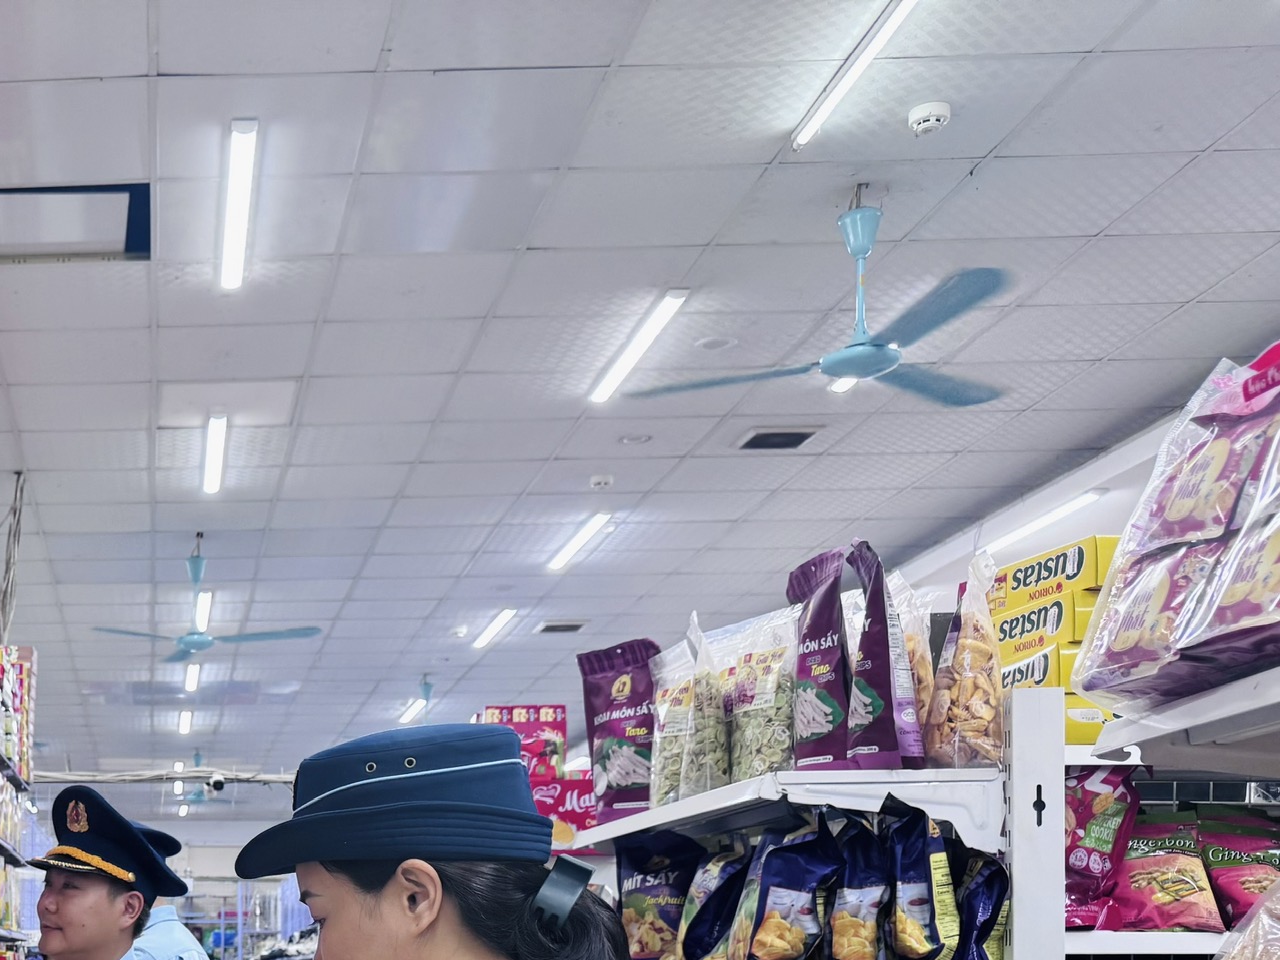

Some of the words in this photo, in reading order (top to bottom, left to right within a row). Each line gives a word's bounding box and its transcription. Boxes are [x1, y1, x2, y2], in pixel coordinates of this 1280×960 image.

[1029, 586, 1058, 602] ORION
[820, 632, 839, 651] SẤY
[1014, 637, 1038, 650] ORION
[810, 664, 830, 677] Taro
[1002, 651, 1050, 690] Custa
[611, 706, 634, 720] MÔN
[625, 726, 648, 738] Taro
[622, 872, 642, 892] MÍT
